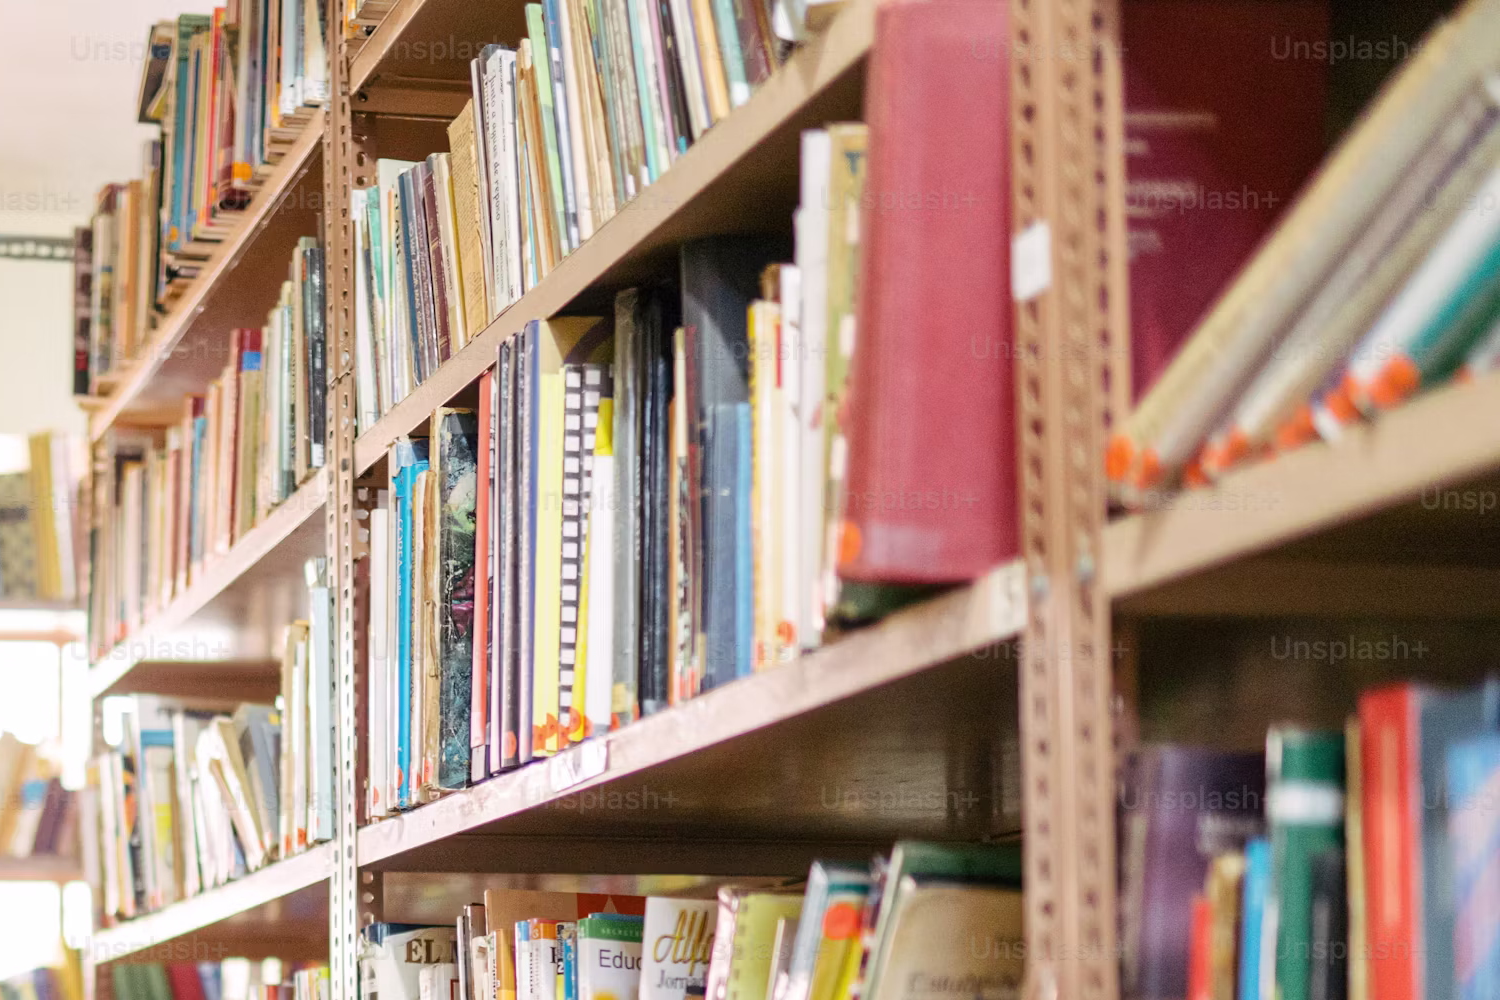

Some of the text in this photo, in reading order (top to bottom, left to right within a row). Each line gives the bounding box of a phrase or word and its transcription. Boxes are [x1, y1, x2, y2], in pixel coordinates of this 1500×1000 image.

[490, 122, 498, 158] aguas
[493, 162, 501, 176] de
[493, 180, 501, 221] reposo
[404, 938, 442, 964] EL
